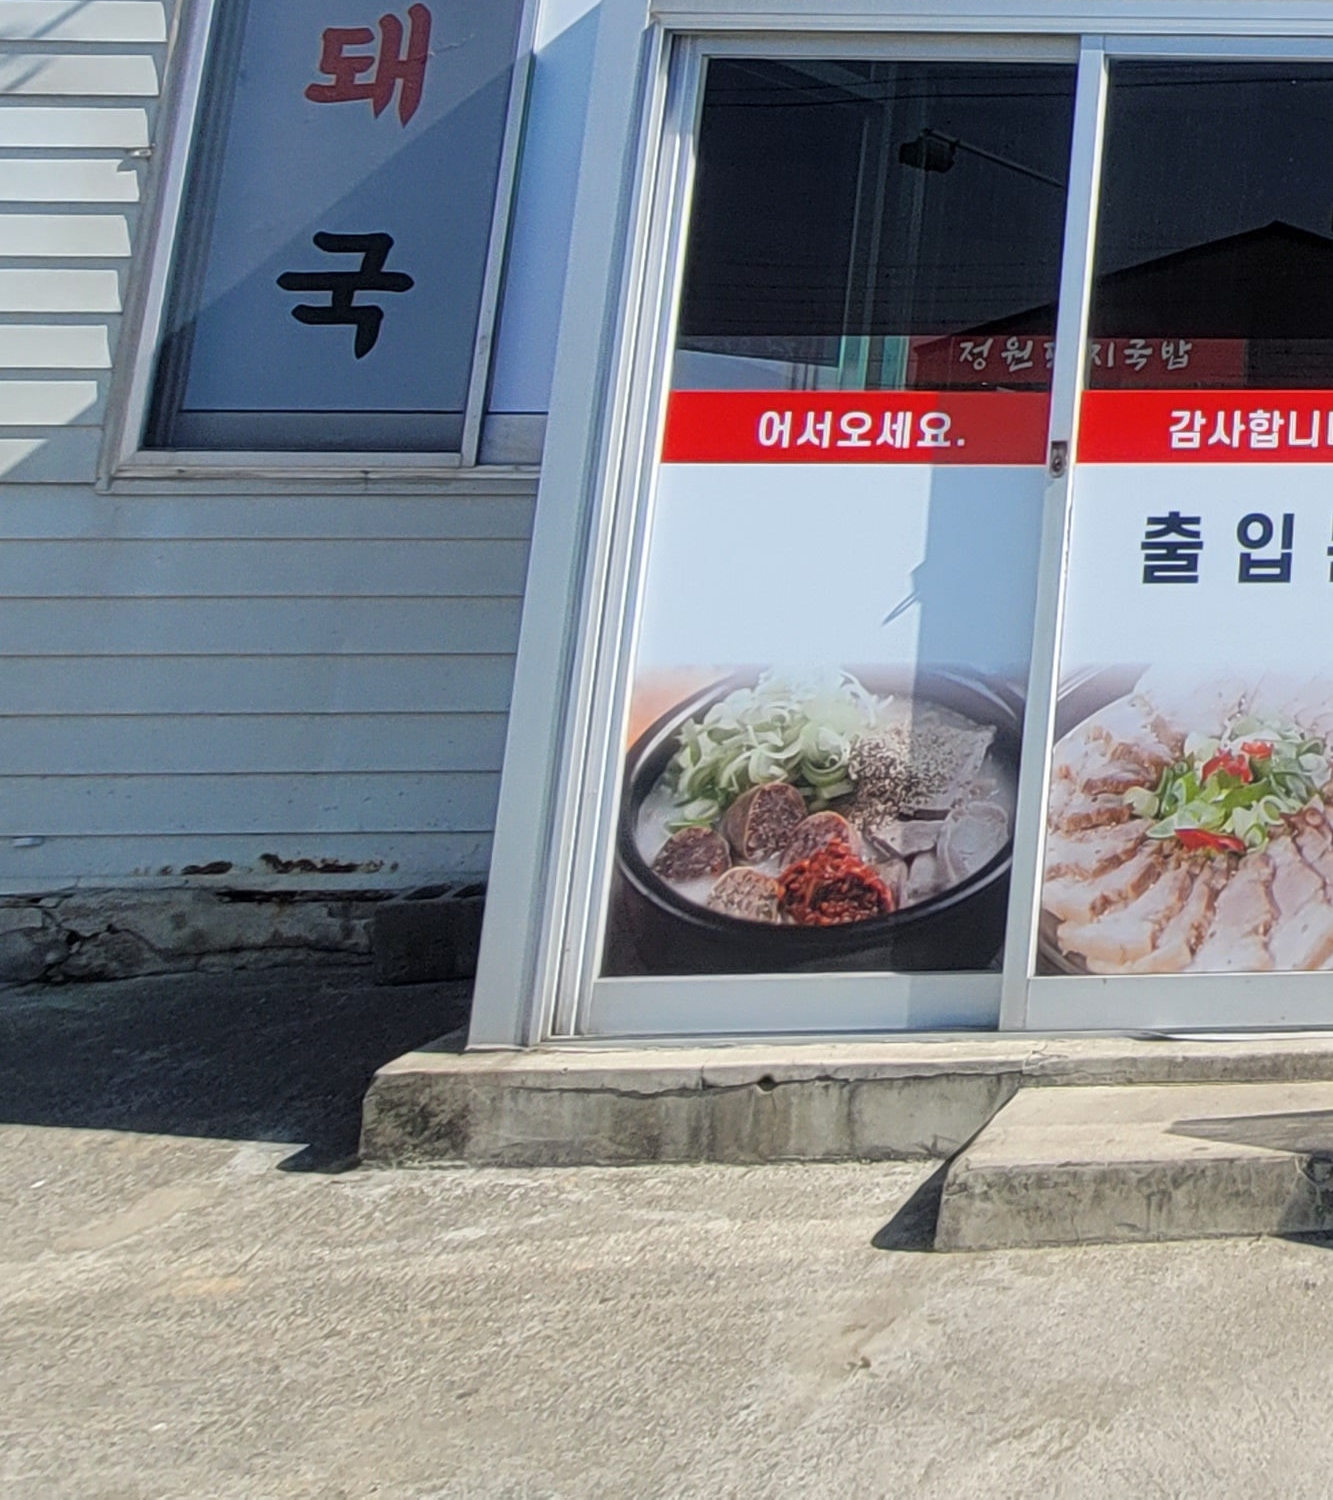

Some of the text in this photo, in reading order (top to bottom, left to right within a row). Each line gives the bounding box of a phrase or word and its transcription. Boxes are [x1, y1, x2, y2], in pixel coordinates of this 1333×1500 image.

[304, 3, 431, 127] 돼
[276, 231, 414, 359] 국
[959, 336, 1034, 372] 정원
[757, 410, 967, 449] 어서오세요.
